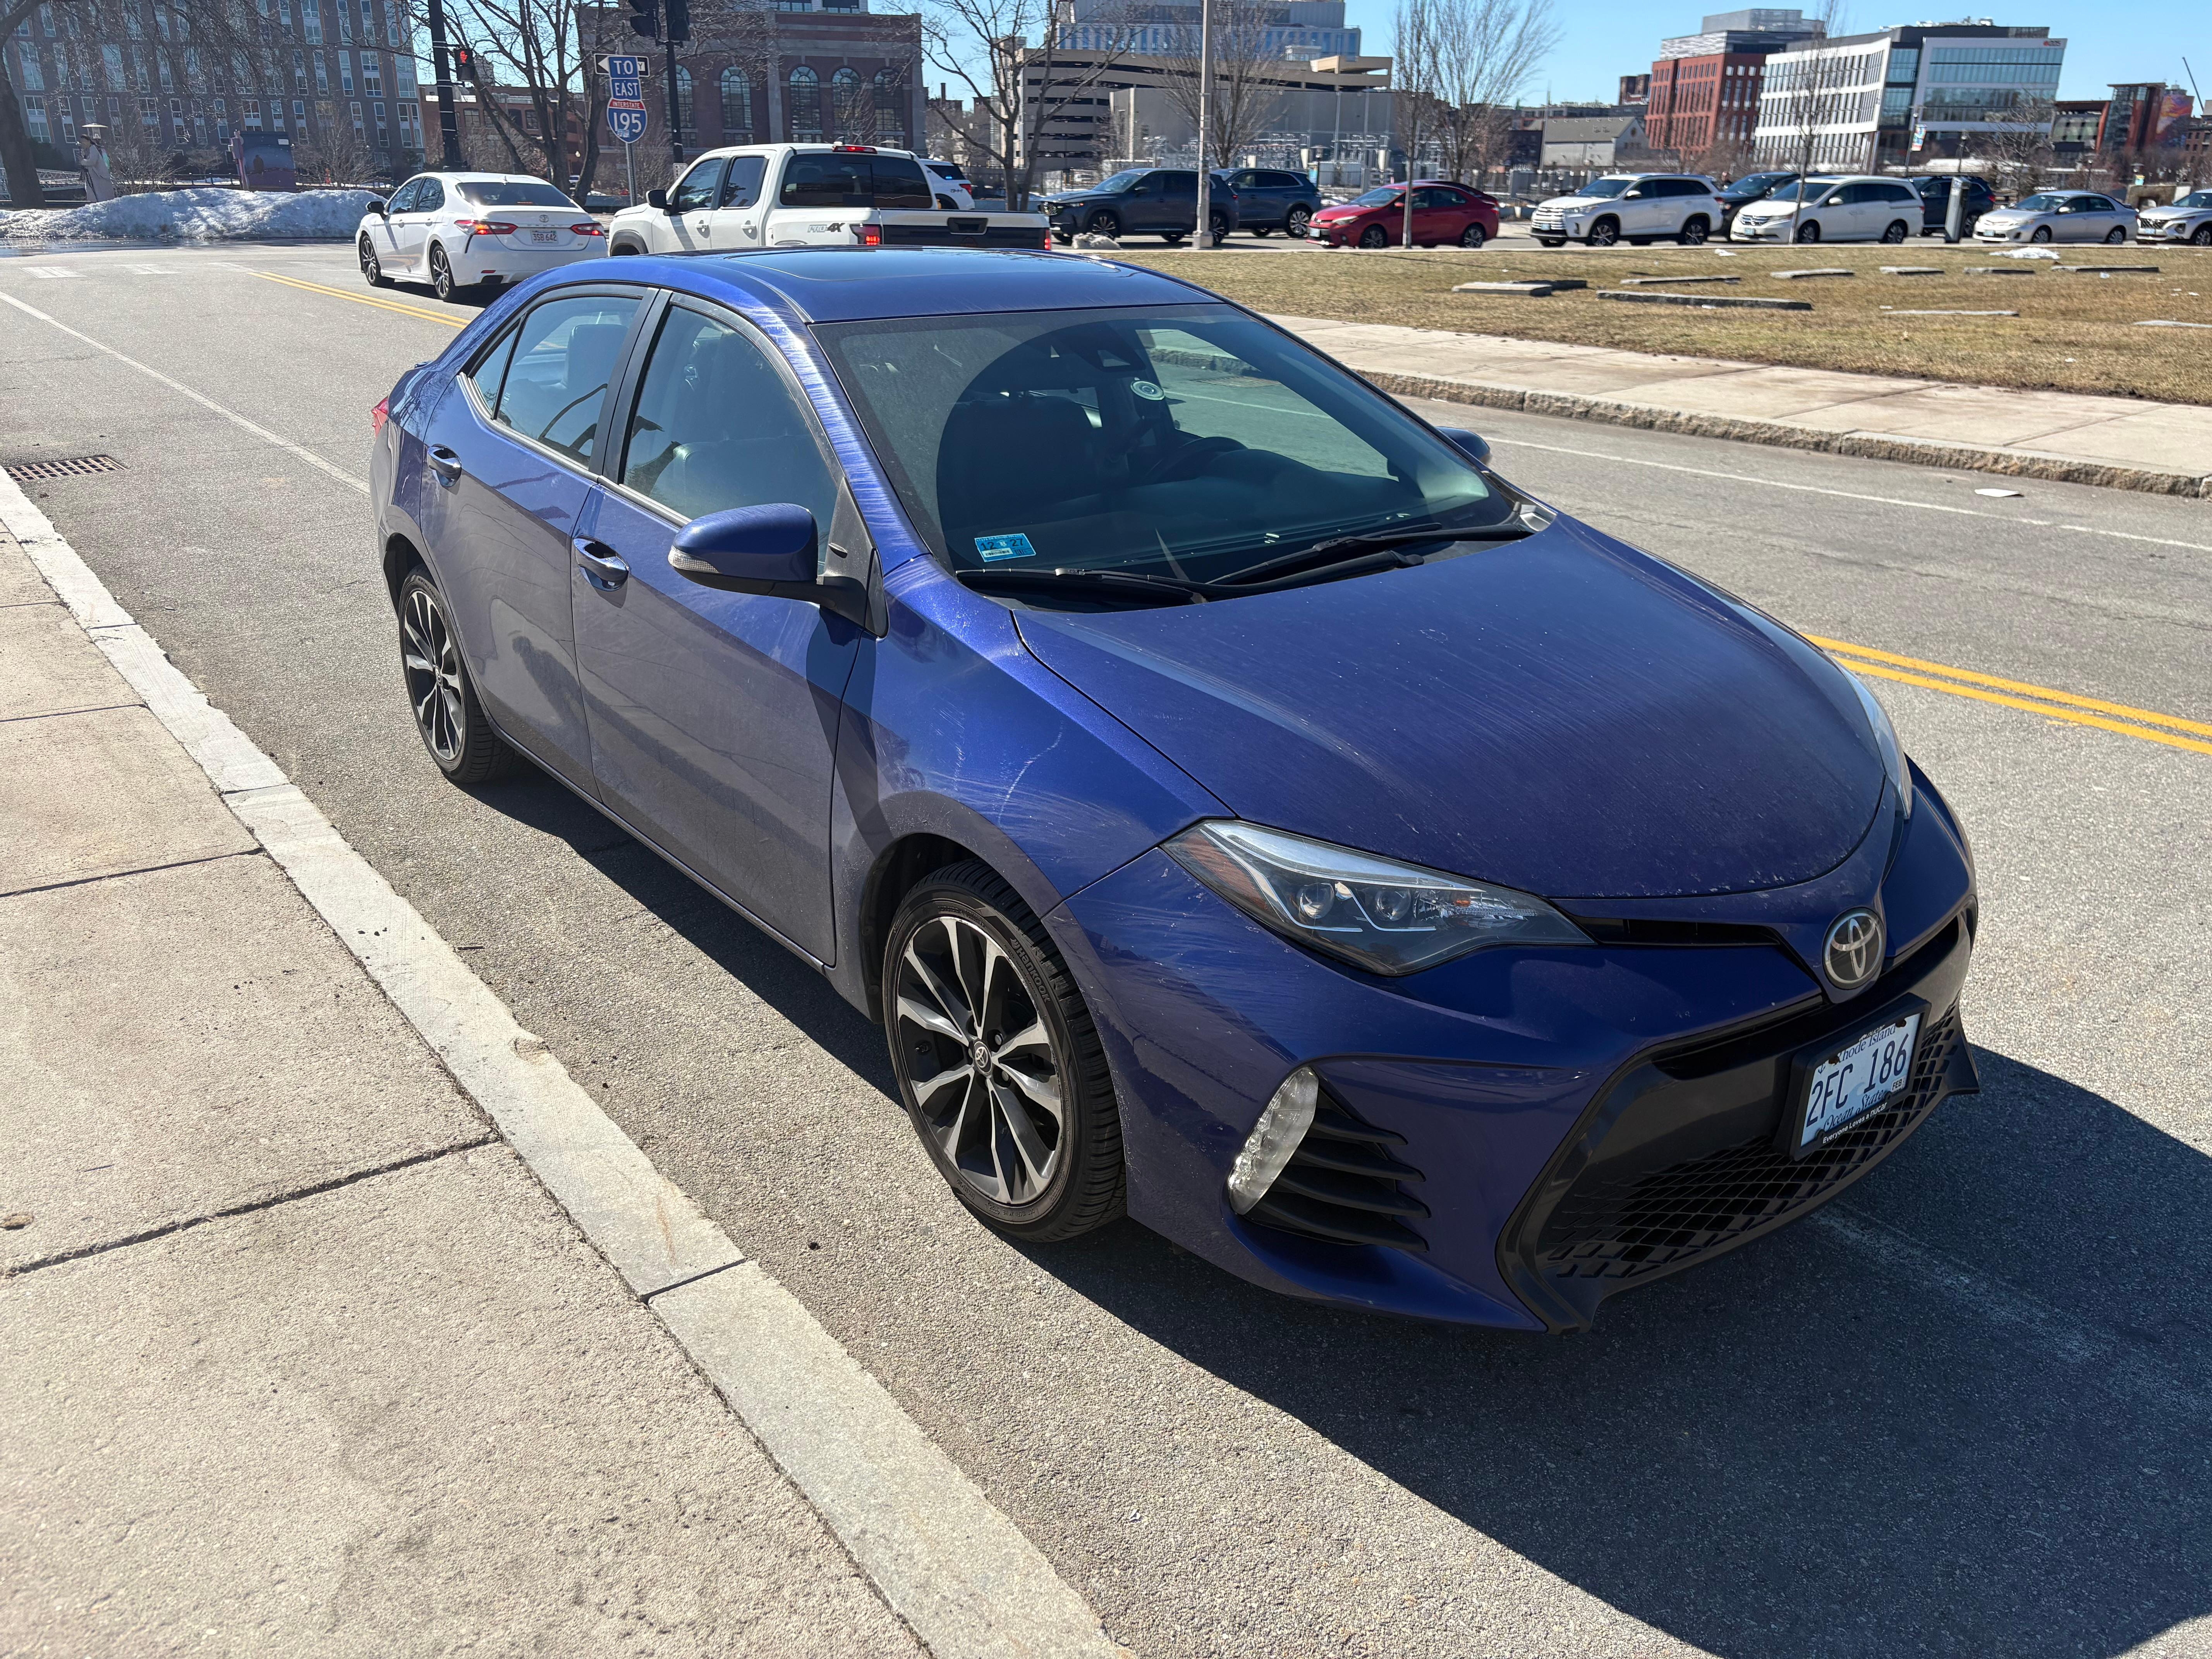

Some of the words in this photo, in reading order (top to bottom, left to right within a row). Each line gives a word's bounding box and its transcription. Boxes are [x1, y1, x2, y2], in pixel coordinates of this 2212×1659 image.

[613, 60, 633, 74] TO
[615, 82, 638, 96] EAST
[614, 112, 642, 133] 195
[981, 541, 997, 551] 12
[1010, 538, 1023, 547] 27
[1868, 1025, 1896, 1047] Island
[1807, 1063, 1853, 1128] 2FC
[1864, 1033, 1909, 1094] 186
[1892, 1079, 1902, 1090] FEB
[1824, 1106, 1854, 1130] Ocean
[1855, 1089, 1884, 1115] State
[1822, 1125, 1848, 1144] Everyone
[1849, 1116, 1865, 1129] Loves
[1870, 1102, 1887, 1117] nucar
